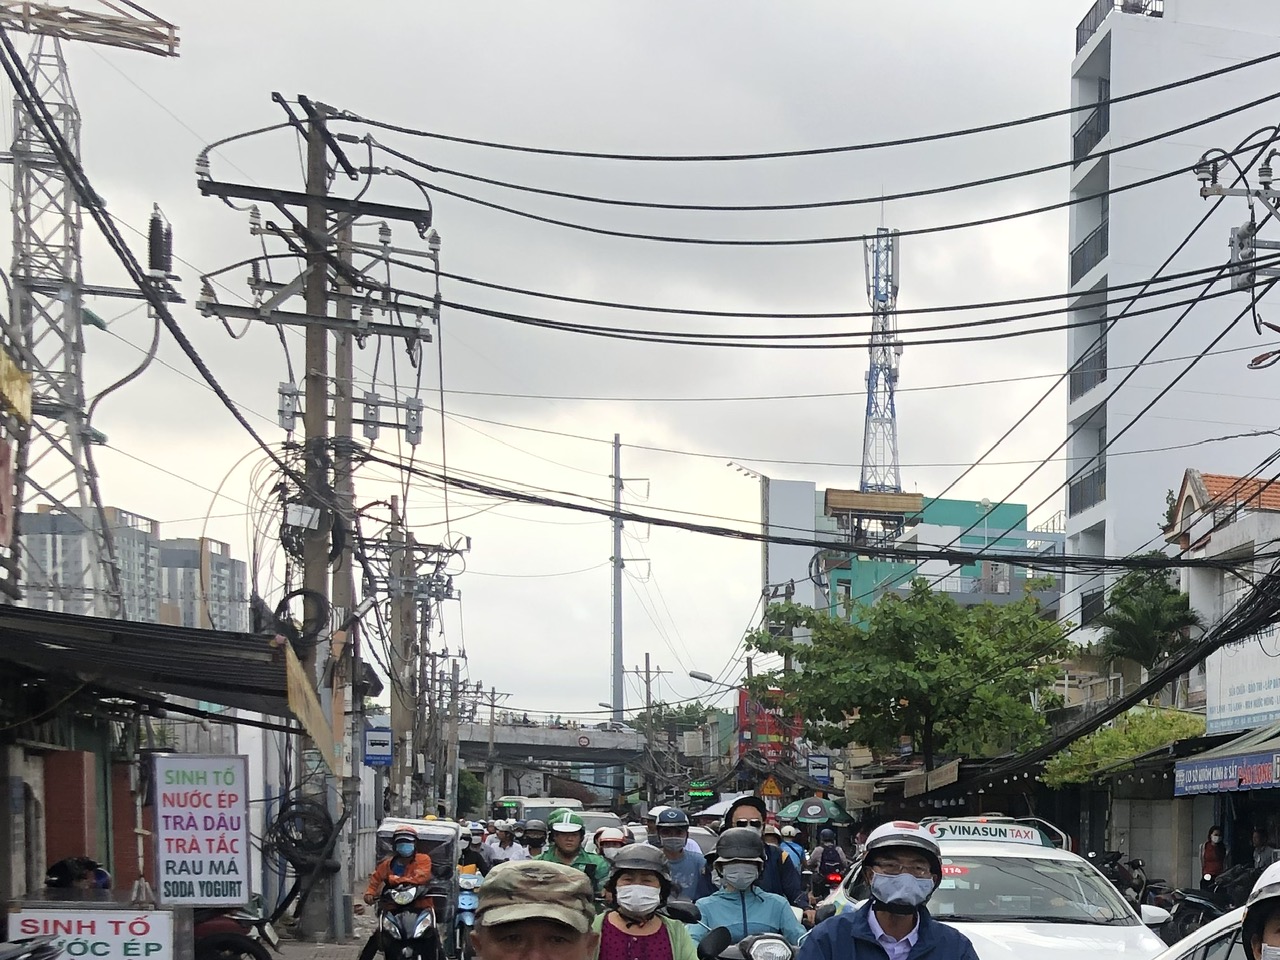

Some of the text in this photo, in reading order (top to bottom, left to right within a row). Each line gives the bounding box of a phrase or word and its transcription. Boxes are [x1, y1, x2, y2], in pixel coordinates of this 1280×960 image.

[165, 766, 235, 786] SINH TỐ
[162, 789, 239, 808] NƯỚC ÉP
[162, 811, 241, 831] TRÀ DÂU
[949, 825, 1034, 840] VINASUN TAXI
[164, 833, 239, 854] TRÀ TẮC
[165, 857, 239, 875] RAU MÁ
[163, 881, 242, 897] SODA YOGURT
[20, 915, 151, 936] SINH TỐ
[123, 938, 163, 957] ÉP
